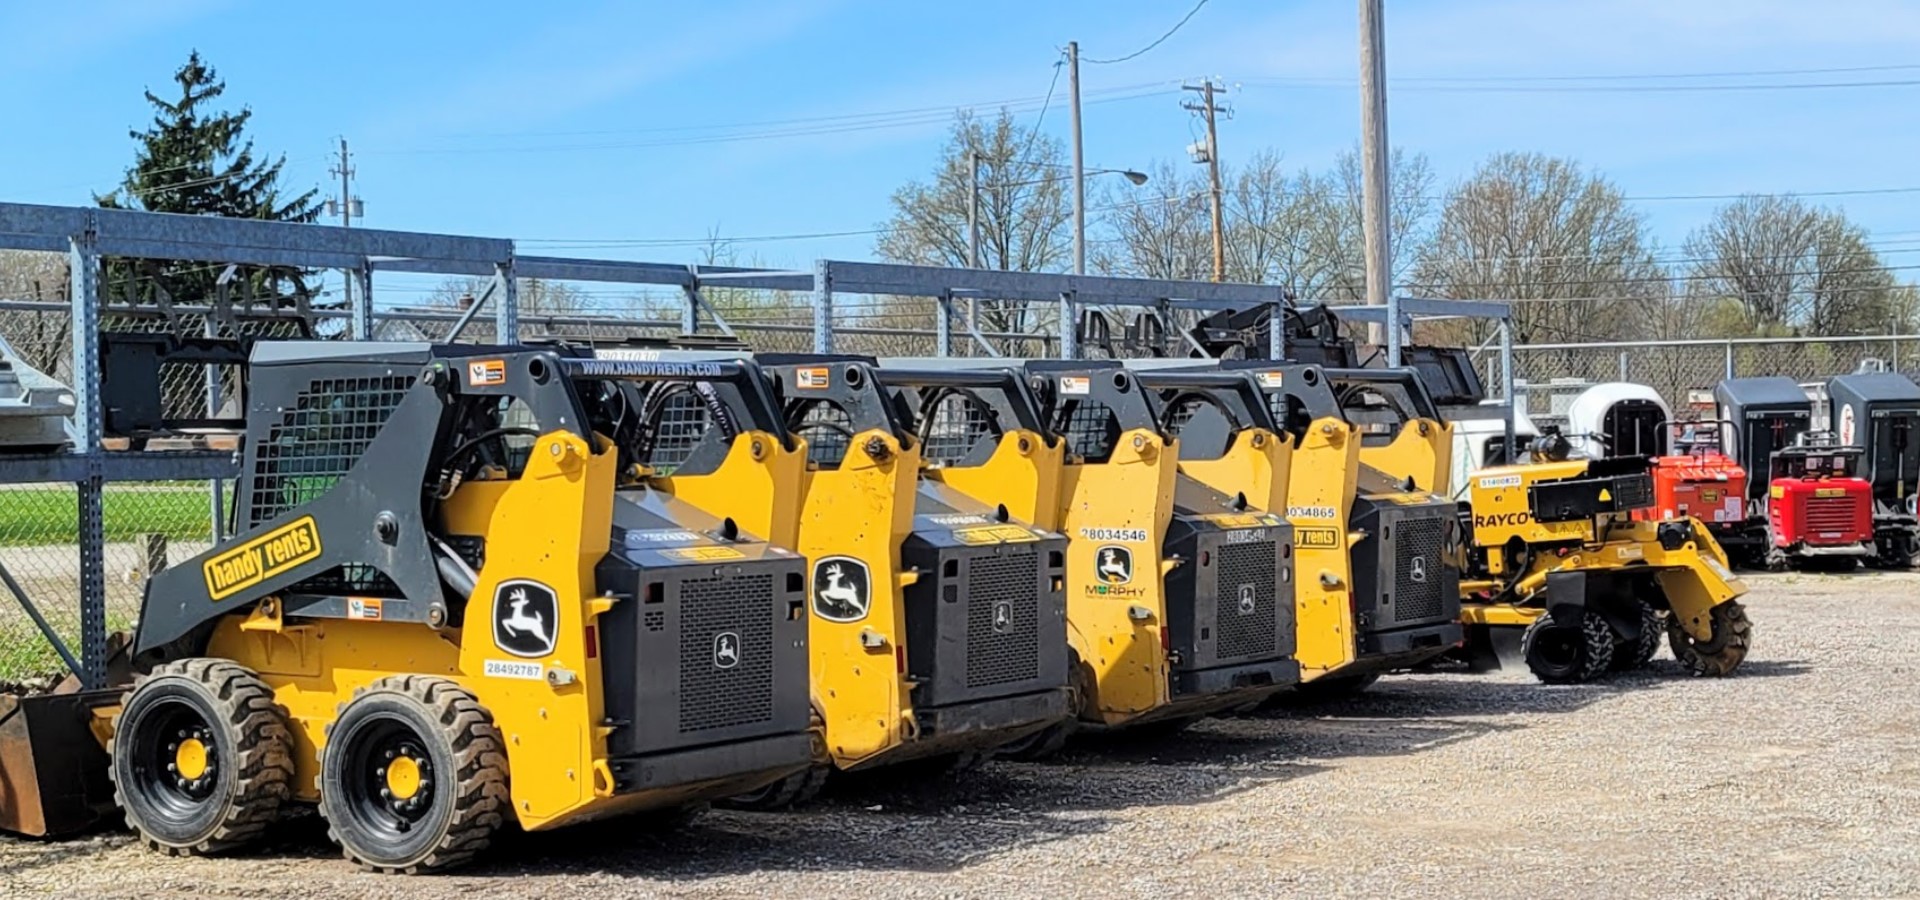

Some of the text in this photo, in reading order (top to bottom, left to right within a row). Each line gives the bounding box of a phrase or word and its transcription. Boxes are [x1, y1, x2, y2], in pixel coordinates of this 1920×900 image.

[582, 362, 722, 376] WWW.HANDYRENTS.COM
[1475, 512, 1528, 528] RAYCO
[1306, 531, 1334, 544] rents
[211, 528, 311, 590] handy rents
[487, 663, 540, 677] 28492787
